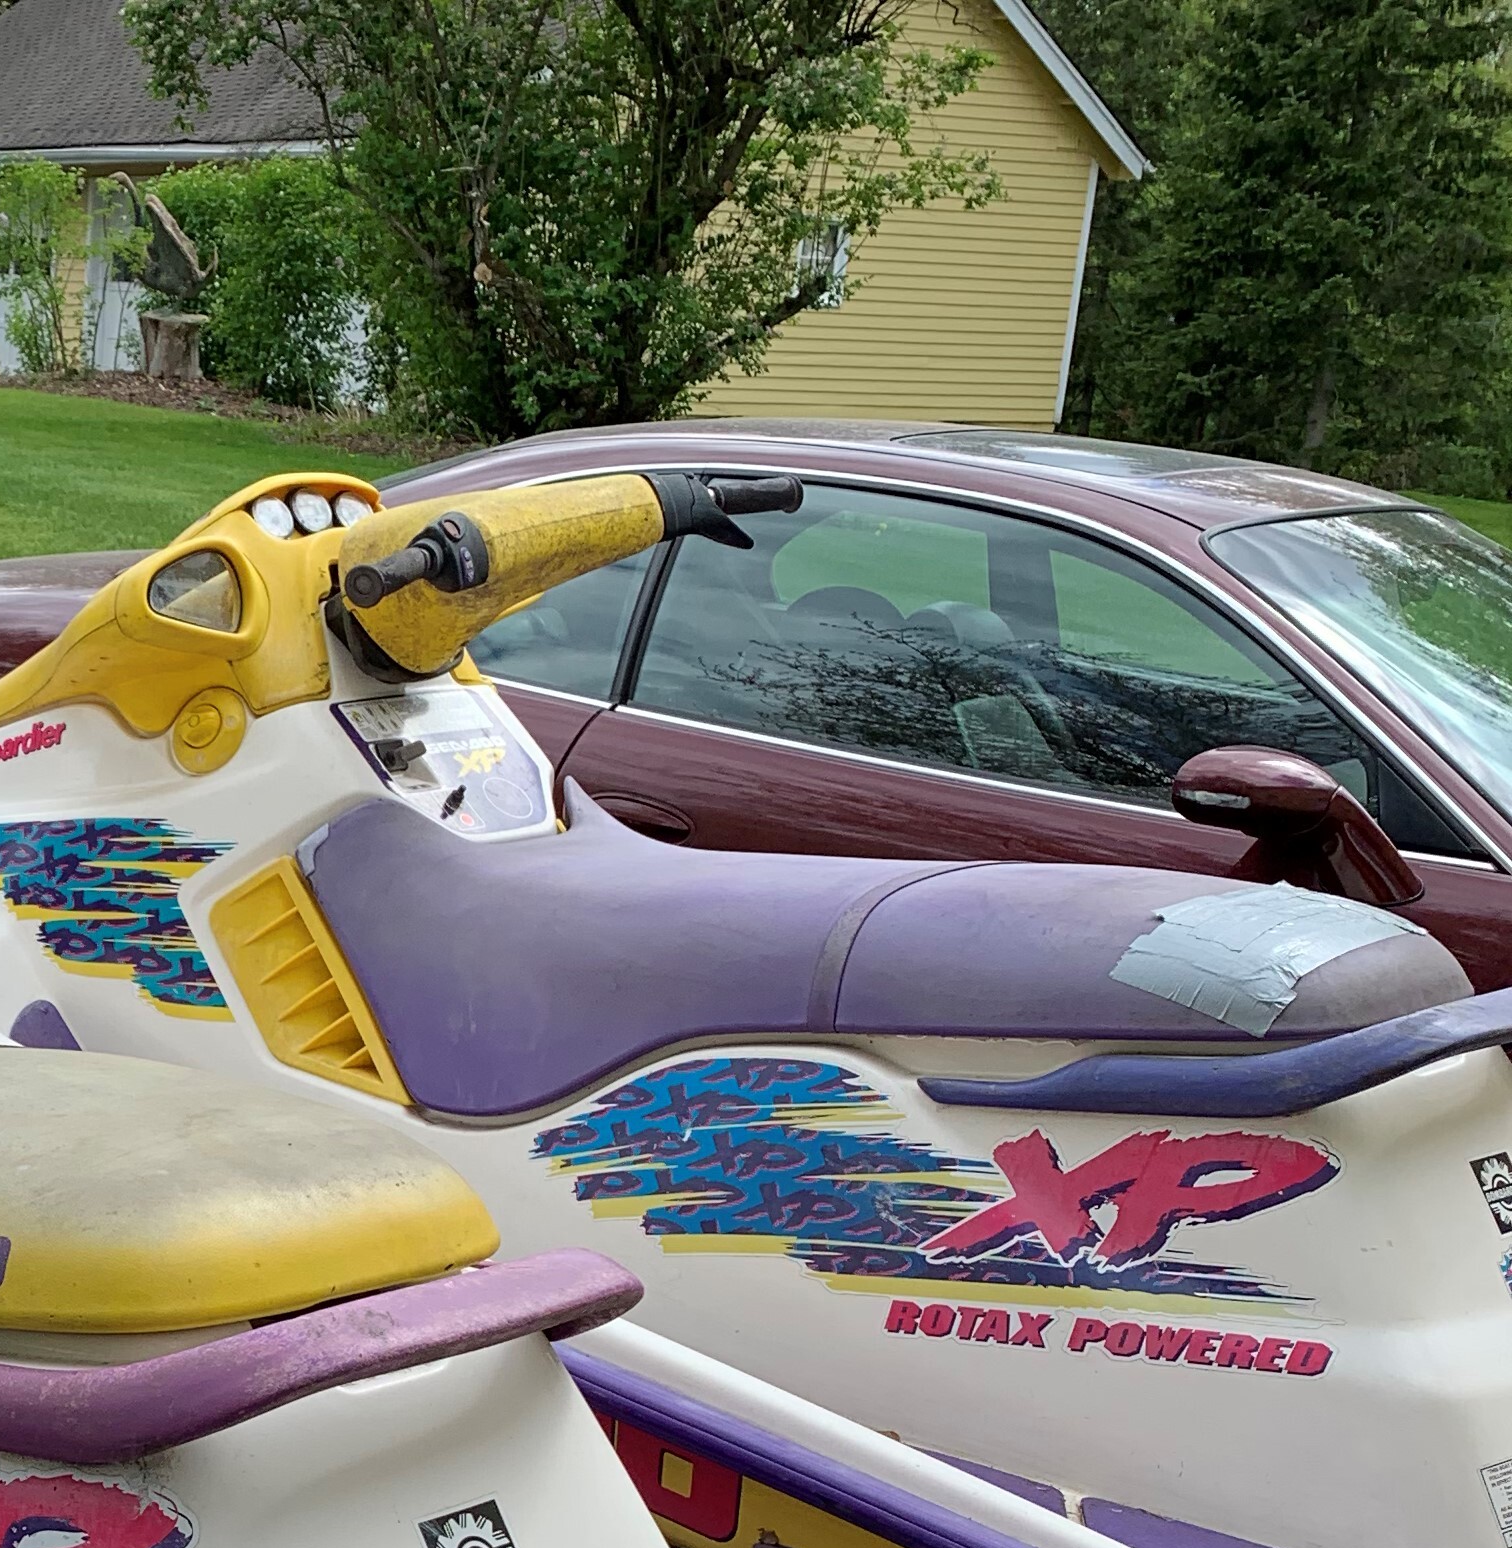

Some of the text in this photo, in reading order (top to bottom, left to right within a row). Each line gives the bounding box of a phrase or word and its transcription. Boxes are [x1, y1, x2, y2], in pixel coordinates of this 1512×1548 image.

[922, 1128, 1341, 1266] XP
[885, 1300, 1333, 1376] ROTAX POWERED
